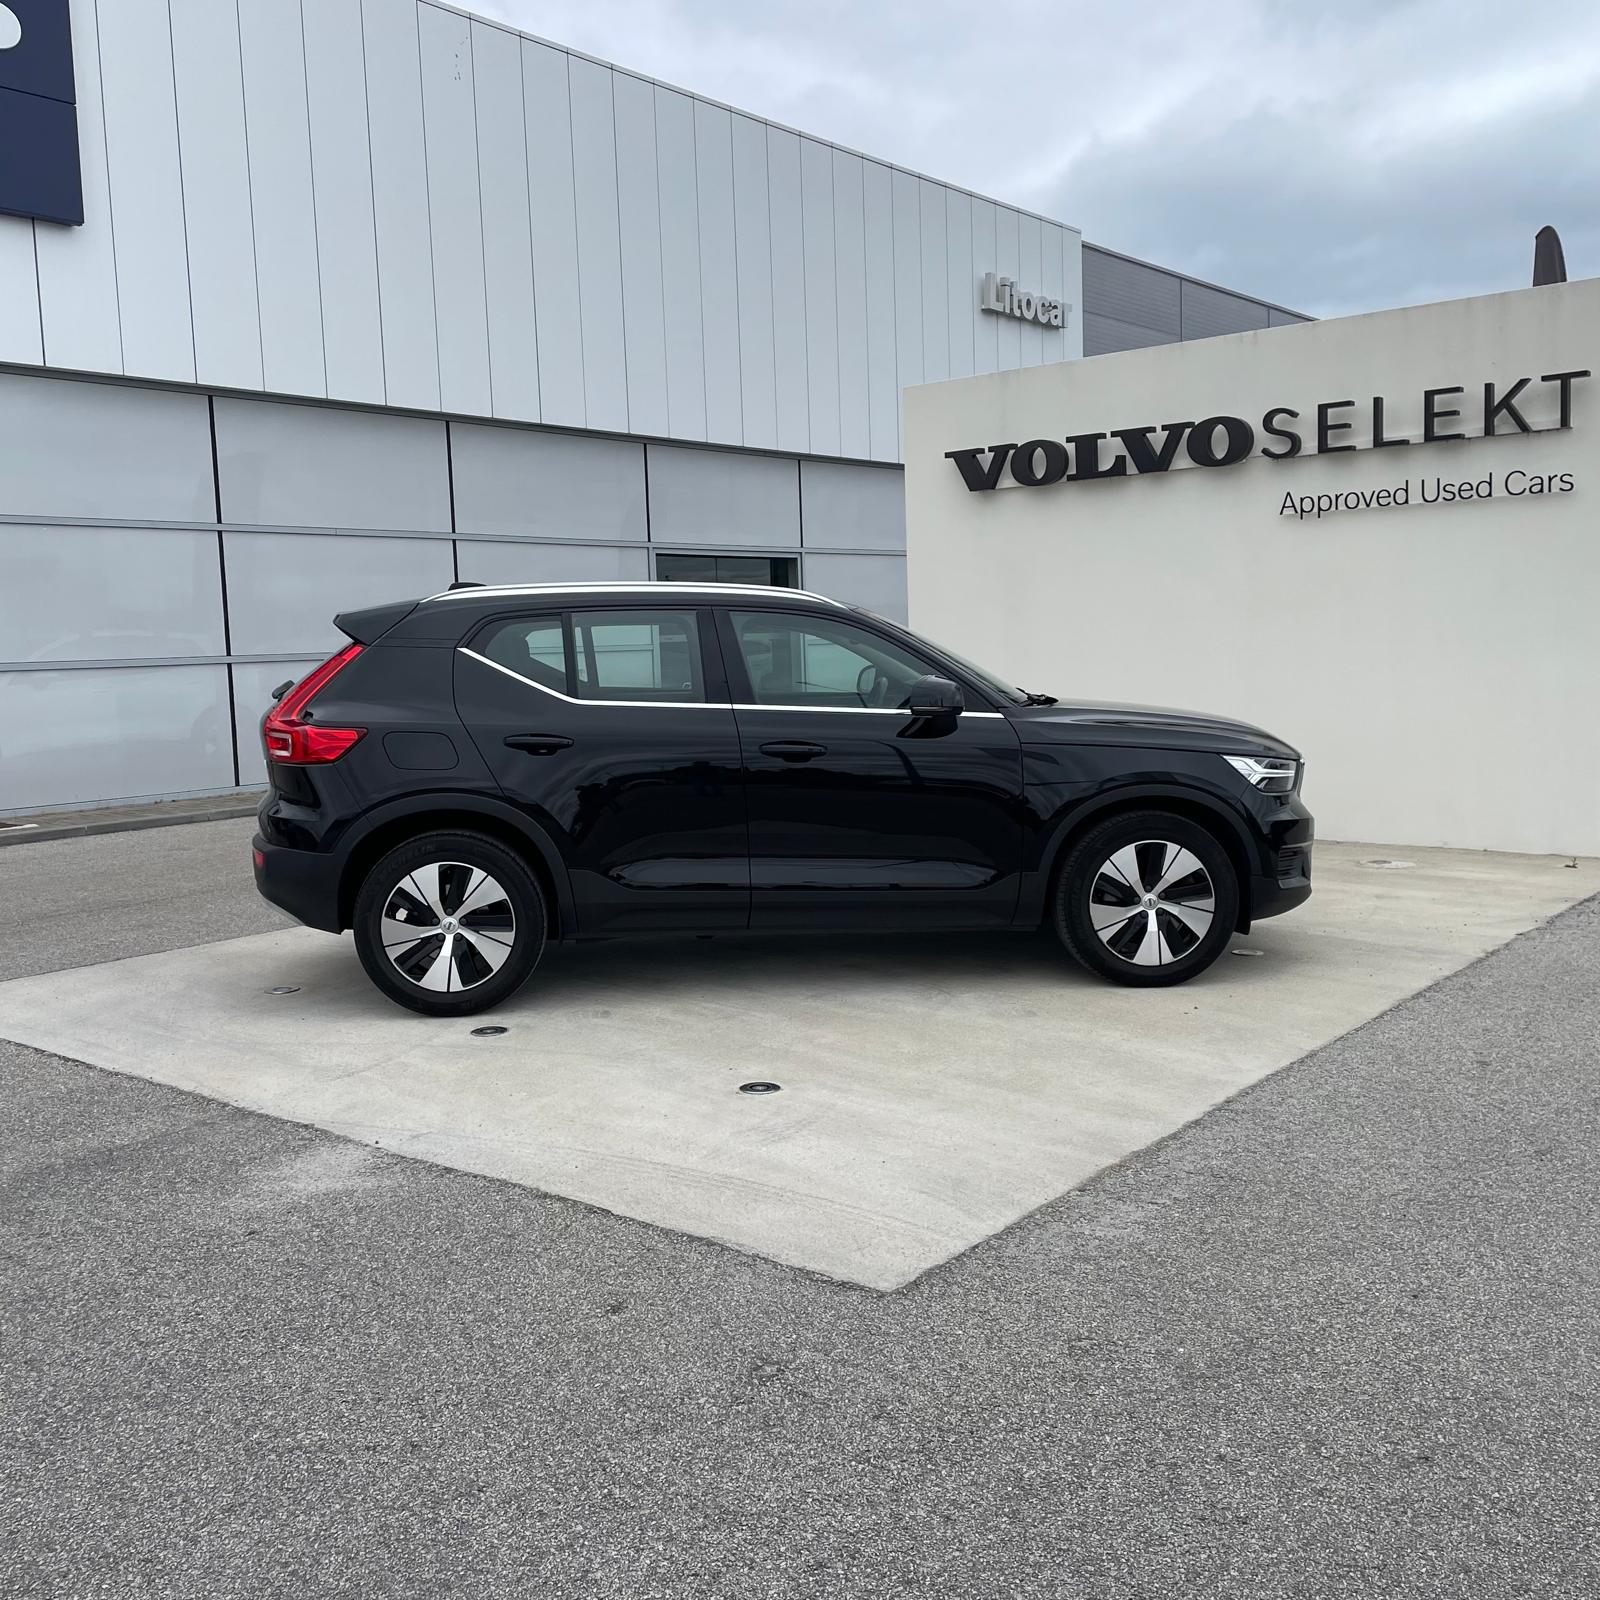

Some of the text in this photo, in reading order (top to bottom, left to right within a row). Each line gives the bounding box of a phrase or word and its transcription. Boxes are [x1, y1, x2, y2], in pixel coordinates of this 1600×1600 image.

[981, 272, 1072, 328] Litocar
[944, 370, 1591, 491] VOLVO SELEKT
[1280, 470, 1575, 519] Approved Used Cars
